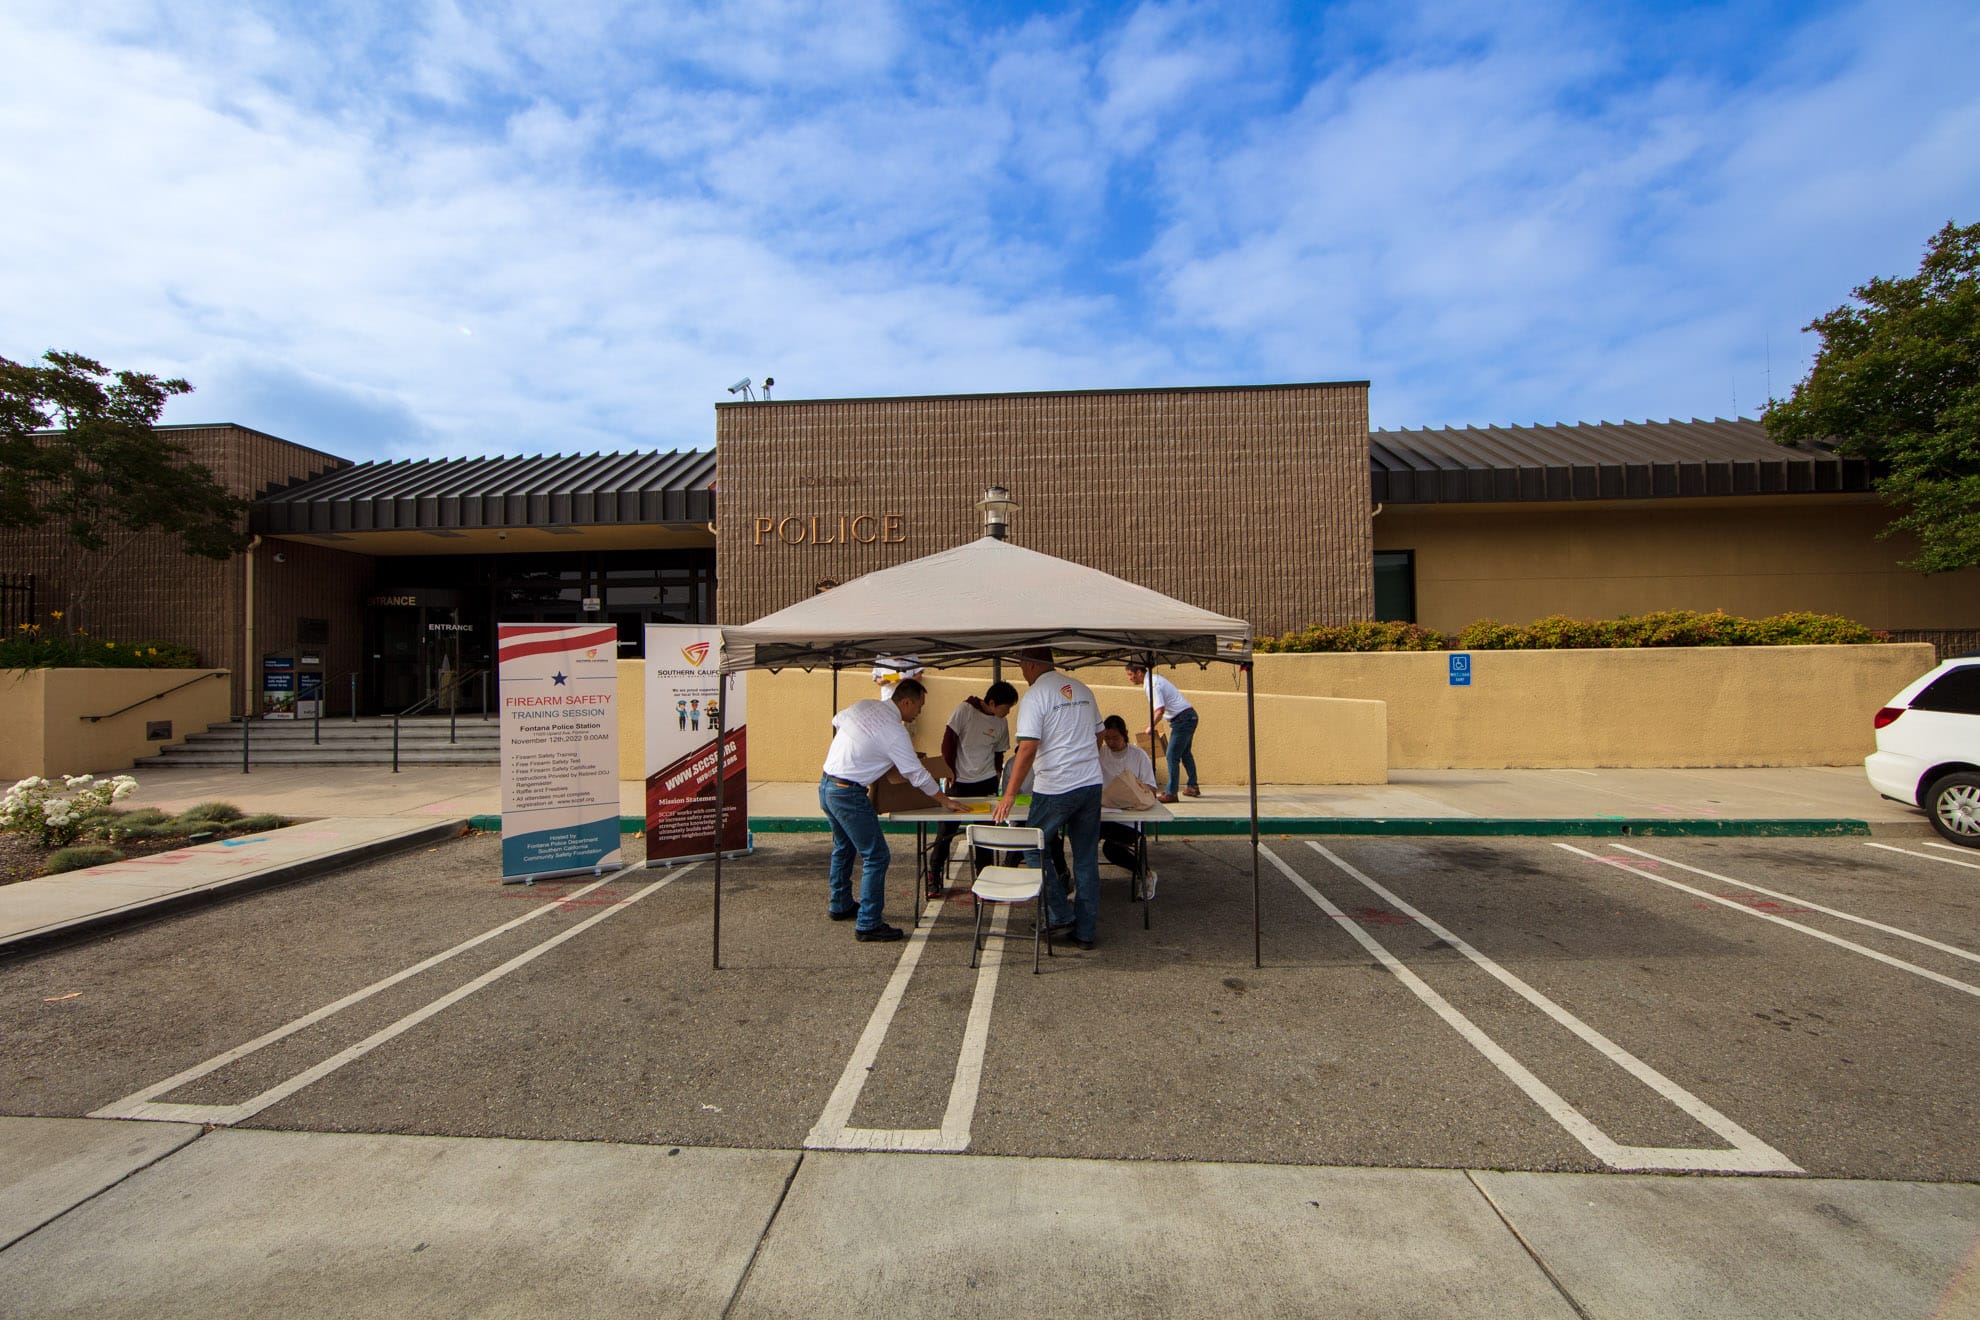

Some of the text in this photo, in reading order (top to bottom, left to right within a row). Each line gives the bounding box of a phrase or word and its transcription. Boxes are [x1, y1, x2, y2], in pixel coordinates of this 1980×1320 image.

[754, 514, 906, 545] POLICE
[506, 694, 612, 707] FIREARM SAFETY
[512, 708, 604, 720] TRAINING SESSION
